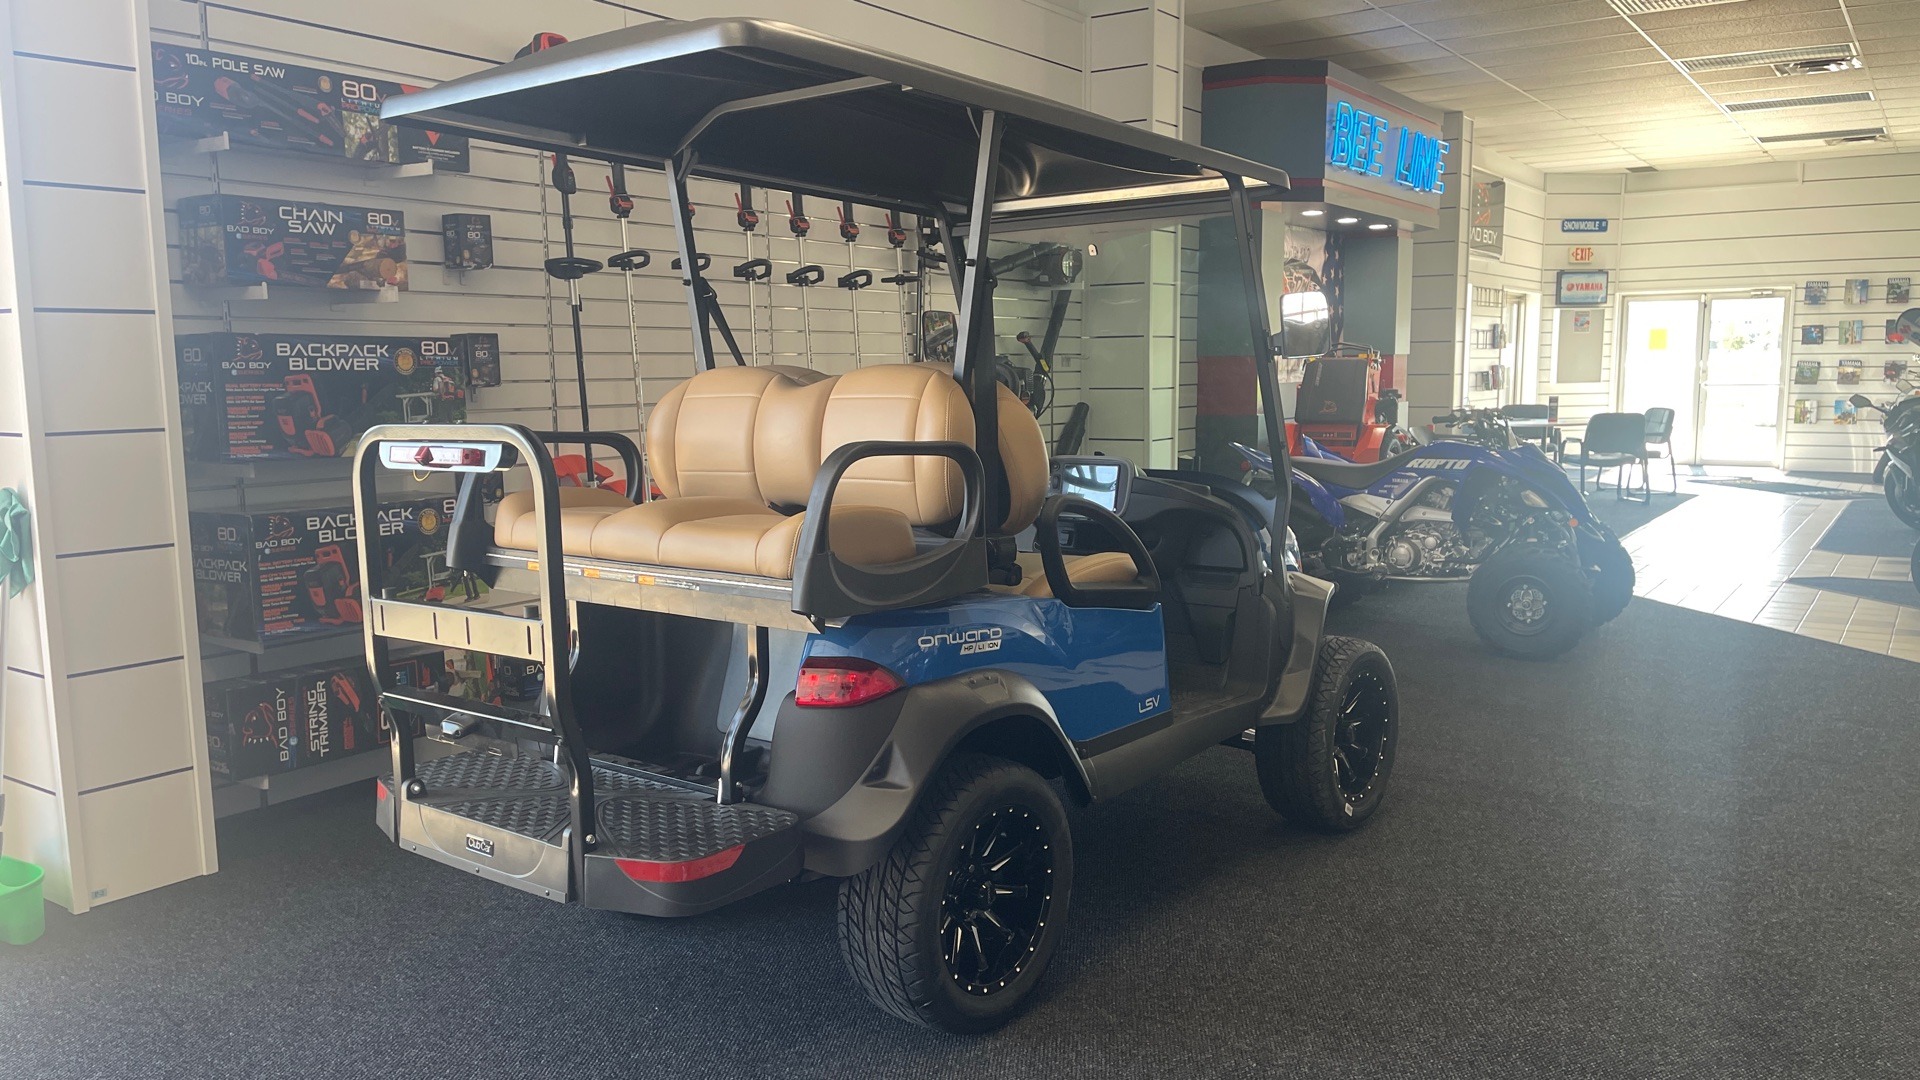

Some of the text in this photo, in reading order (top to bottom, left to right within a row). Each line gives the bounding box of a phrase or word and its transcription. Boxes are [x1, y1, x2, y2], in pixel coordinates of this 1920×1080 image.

[212, 57, 249, 74] POLE
[253, 64, 285, 79] SAW
[166, 92, 204, 107] BOY
[341, 98, 380, 109] LITHIU
[1331, 100, 1449, 195] BEE LINE
[279, 206, 343, 224] CHAIN
[226, 224, 275, 236] BAD BOY
[287, 219, 336, 236] SAW
[1563, 220, 1599, 231] SNOWMOBILE
[1470, 227, 1498, 244] AD BOY
[1575, 247, 1592, 261] EXIT
[1575, 283, 1603, 292] YAMAHA
[275, 342, 389, 357] BACKPACK
[221, 361, 272, 369] BAD BOY
[289, 357, 379, 371] BLOWER
[255, 537, 303, 549] BAD BOY
[193, 558, 247, 573] ACKPACK
[195, 569, 242, 584] BLOWER
[526, 664, 544, 675] BA
[1138, 695, 1160, 714] LSV
[275, 687, 290, 762] BAD BOY
[307, 689, 320, 752] STRING
[316, 680, 330, 758] TRIMMER
